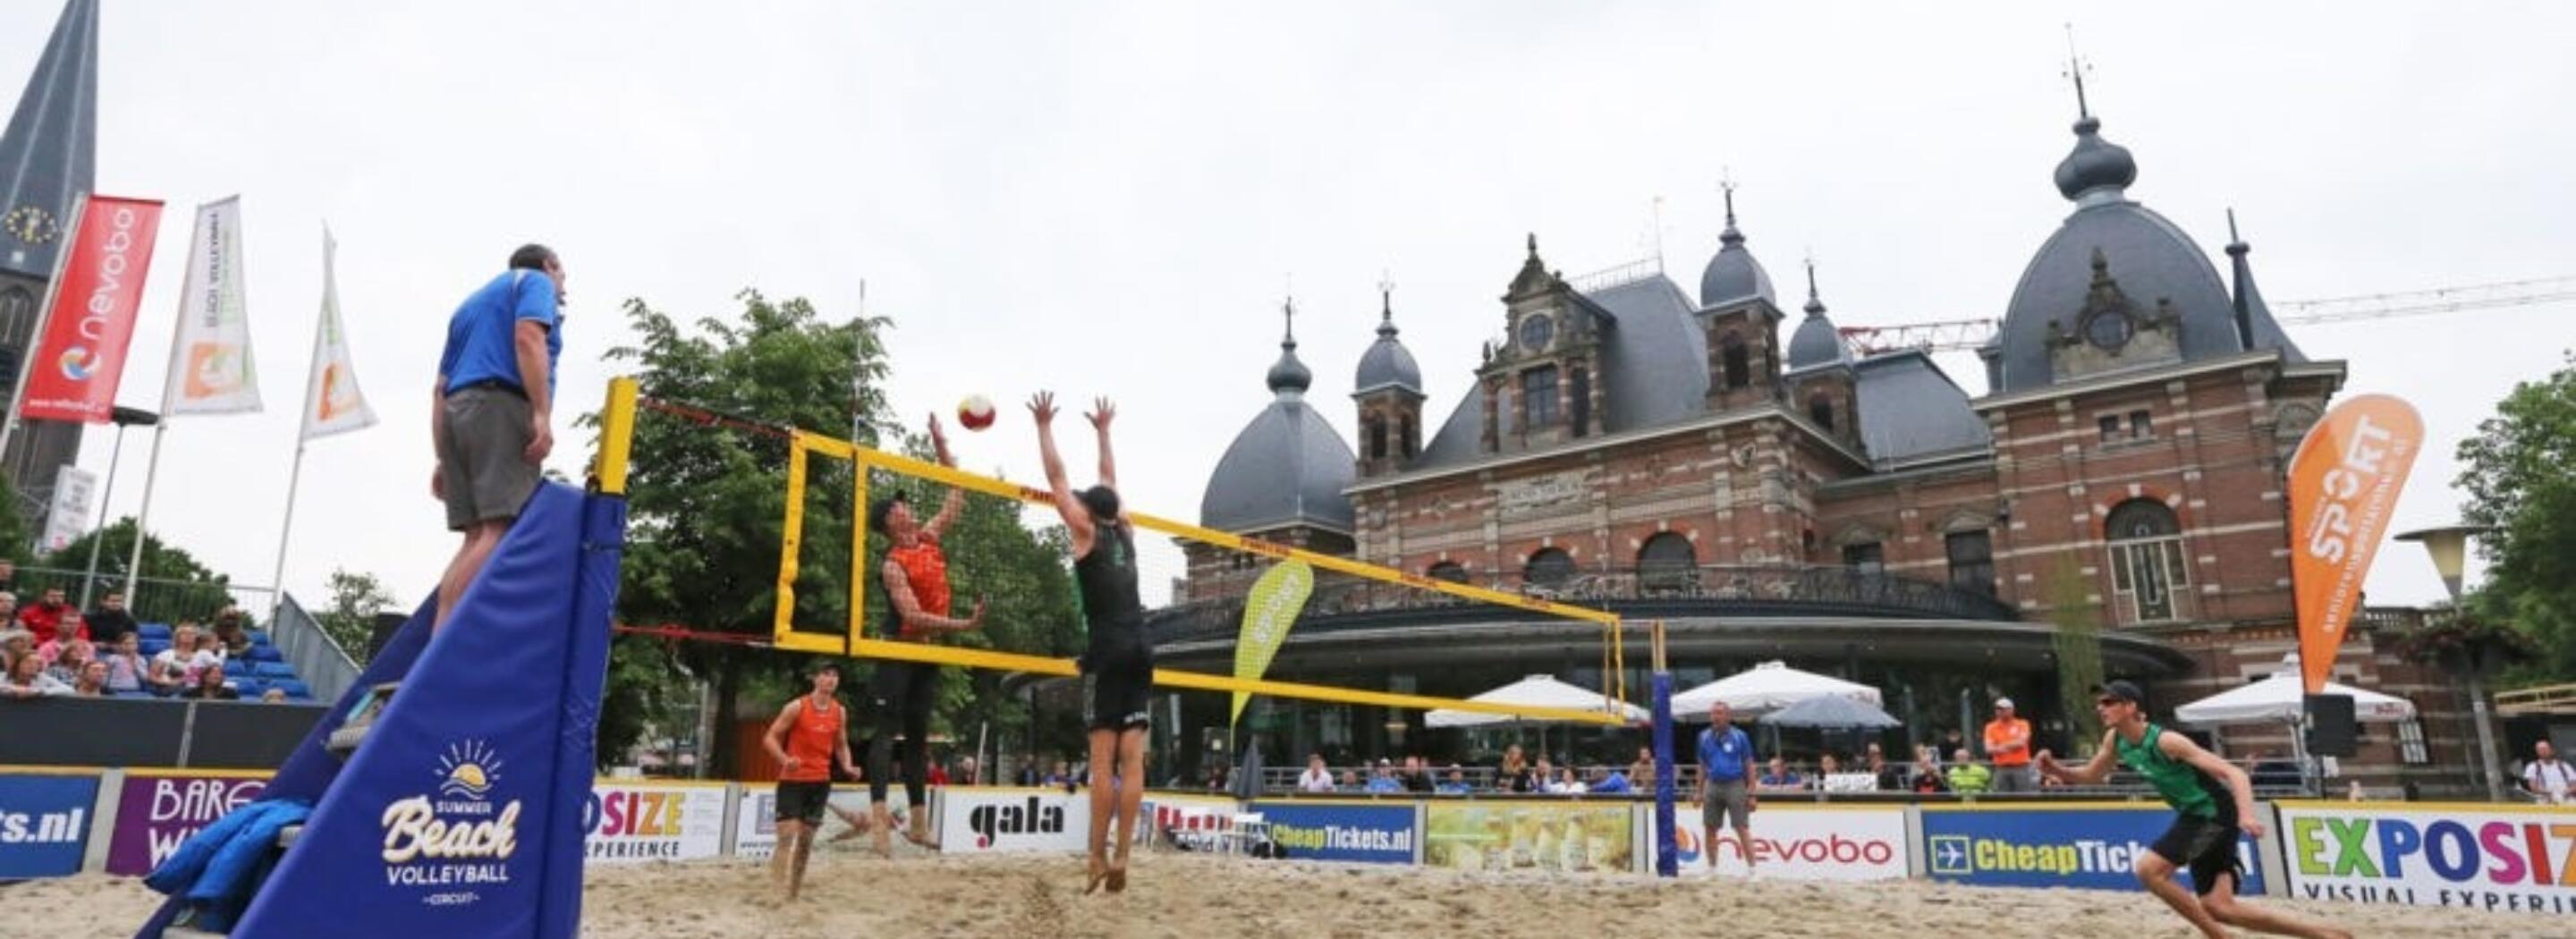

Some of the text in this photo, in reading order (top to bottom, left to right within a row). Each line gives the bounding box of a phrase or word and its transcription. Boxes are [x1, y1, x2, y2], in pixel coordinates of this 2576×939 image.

[80, 207, 134, 341] nevobo
[2309, 414, 2391, 564] SPORT
[436, 801, 491, 813] SUMMER
[970, 796, 1064, 848] gala
[0, 808, 83, 842] s.nl
[382, 795, 521, 862] Beach
[1273, 825, 1411, 851] CheapTickets.nl
[1710, 833, 1892, 865] nevobo
[386, 865, 509, 885] VOLLEYBALL
